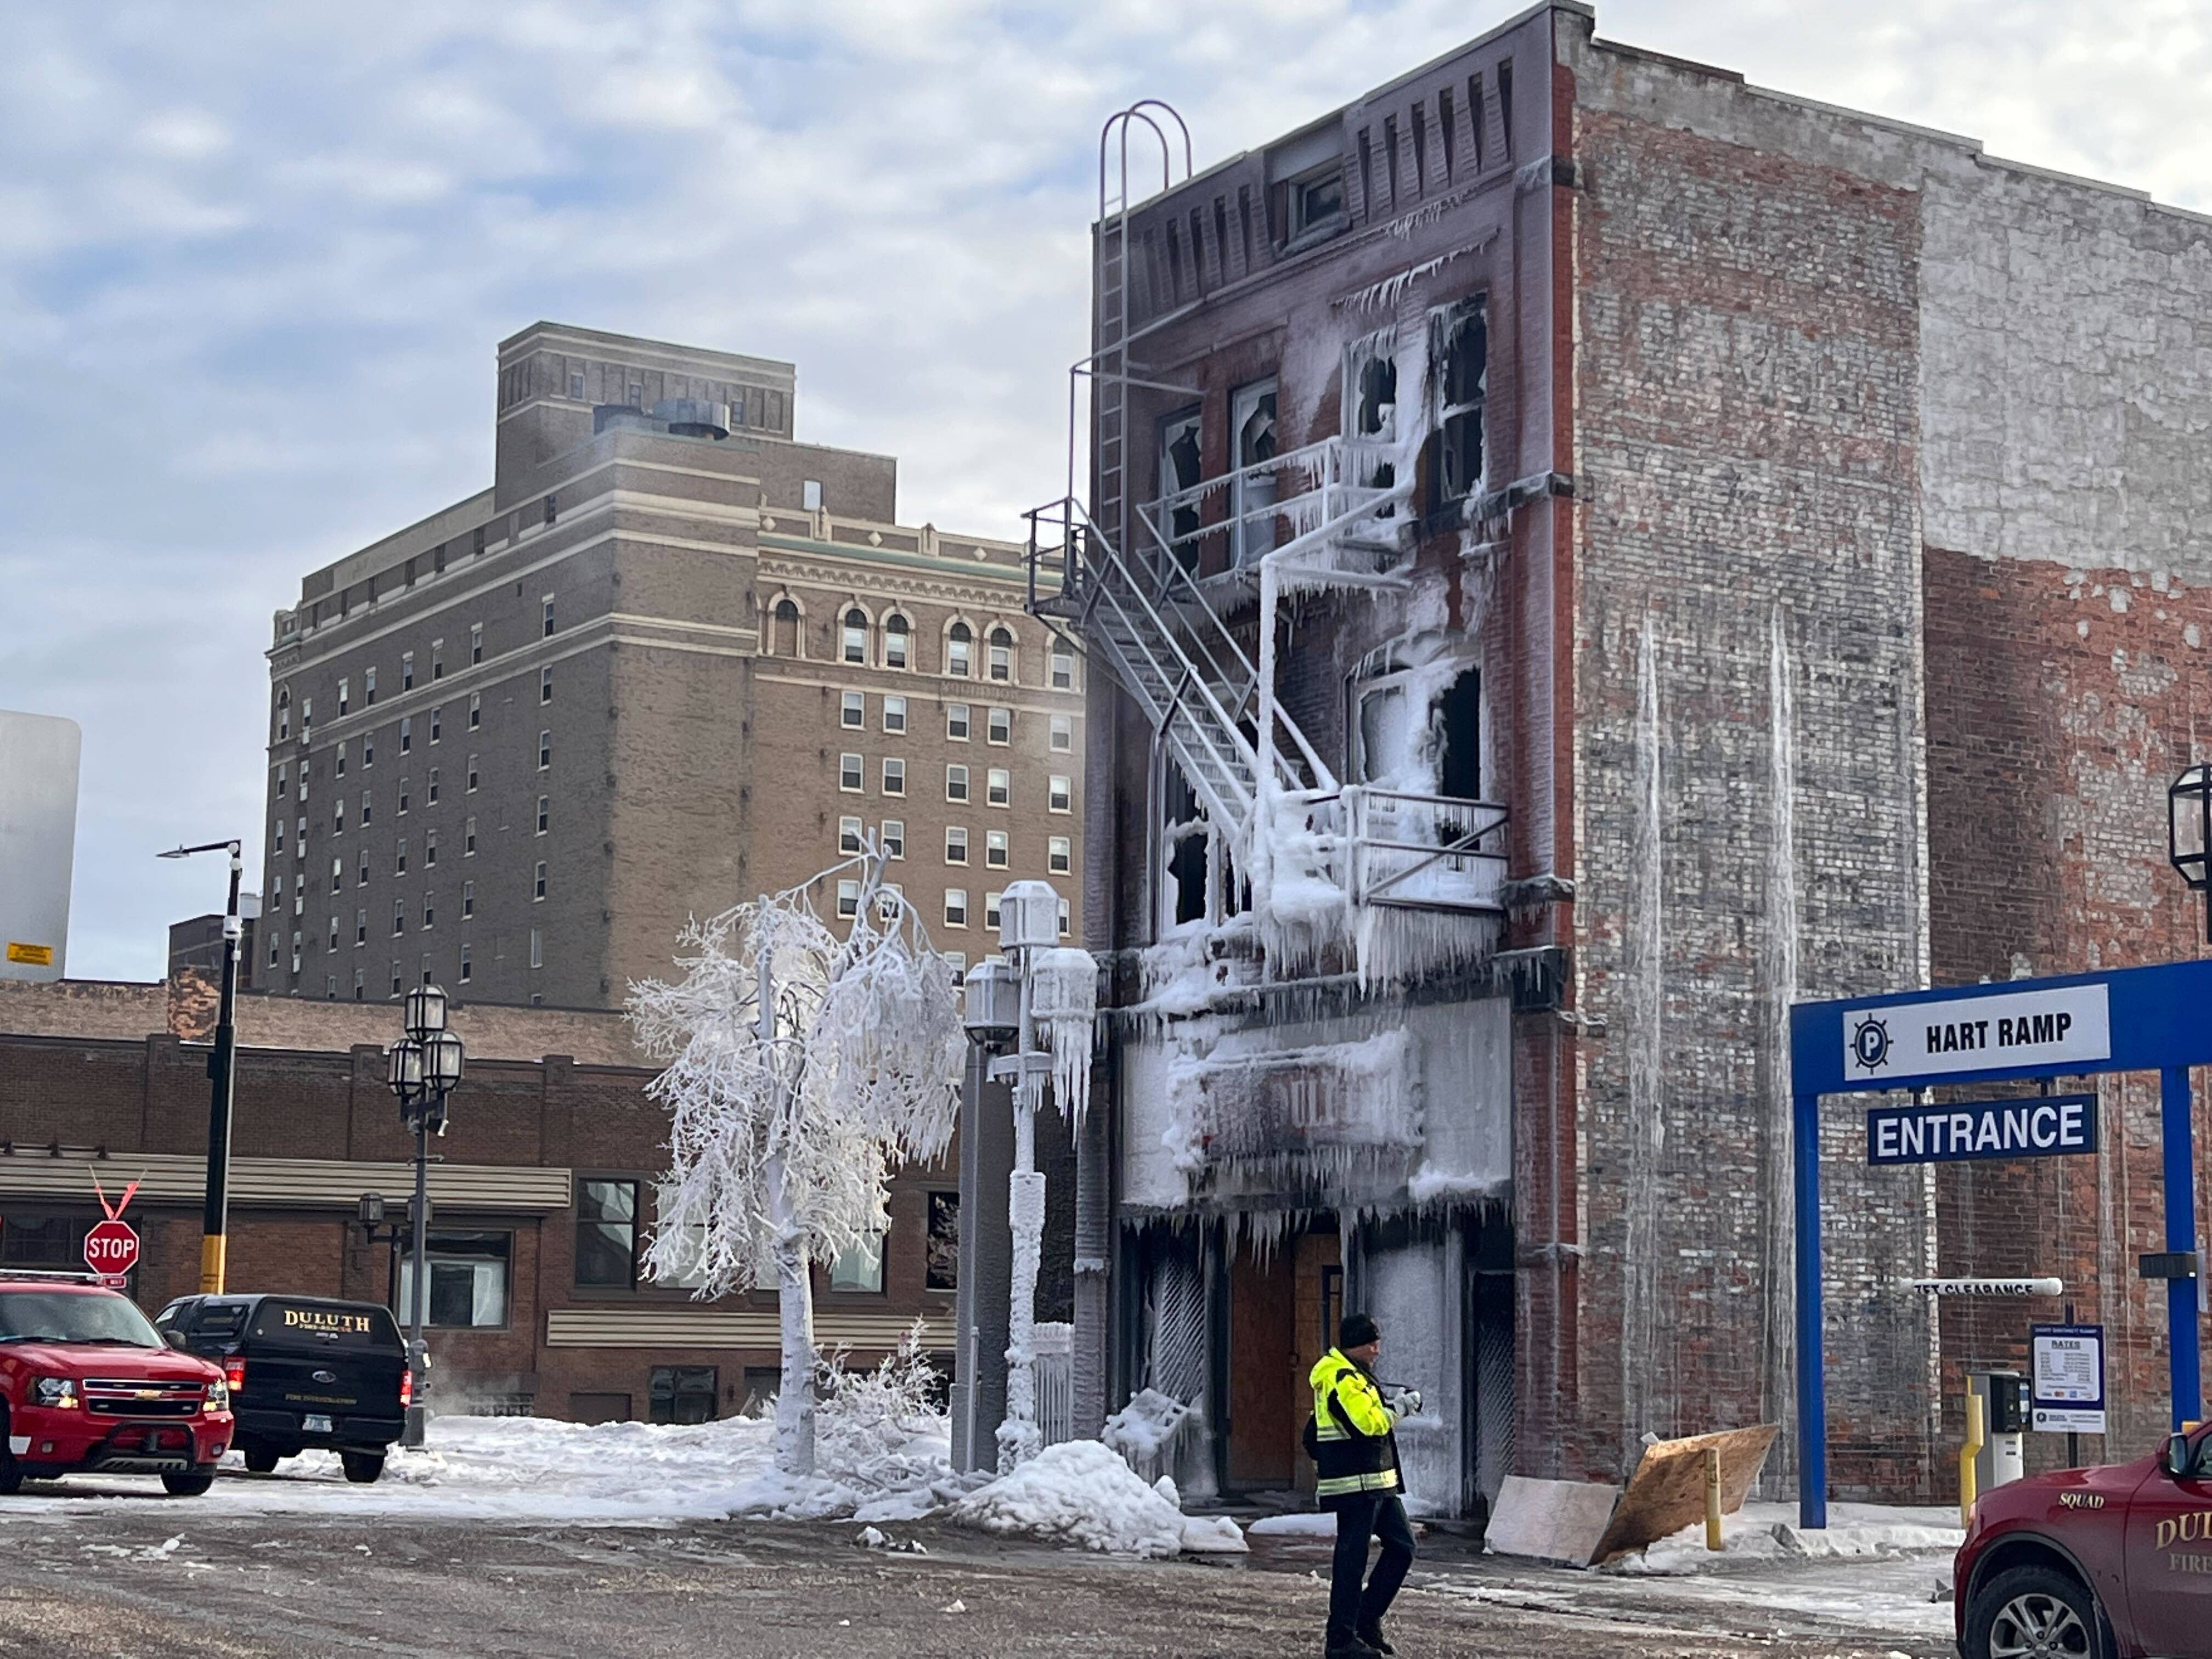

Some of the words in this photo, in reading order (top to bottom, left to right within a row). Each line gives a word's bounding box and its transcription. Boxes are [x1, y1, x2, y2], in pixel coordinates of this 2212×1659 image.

[1926, 1020, 1988, 1054] HART
[1998, 1012, 2072, 1047] RAMP
[1865, 1031, 1878, 1058] P
[1877, 1104, 2084, 1158] ENTRANCE
[88, 1237, 135, 1259] STOP
[1945, 1284, 2033, 1295] CLEARANCE
[284, 1310, 370, 1333] DULUTH
[2058, 1492, 2104, 1509] SQUAD
[2168, 1553, 2212, 1573] FIRE
